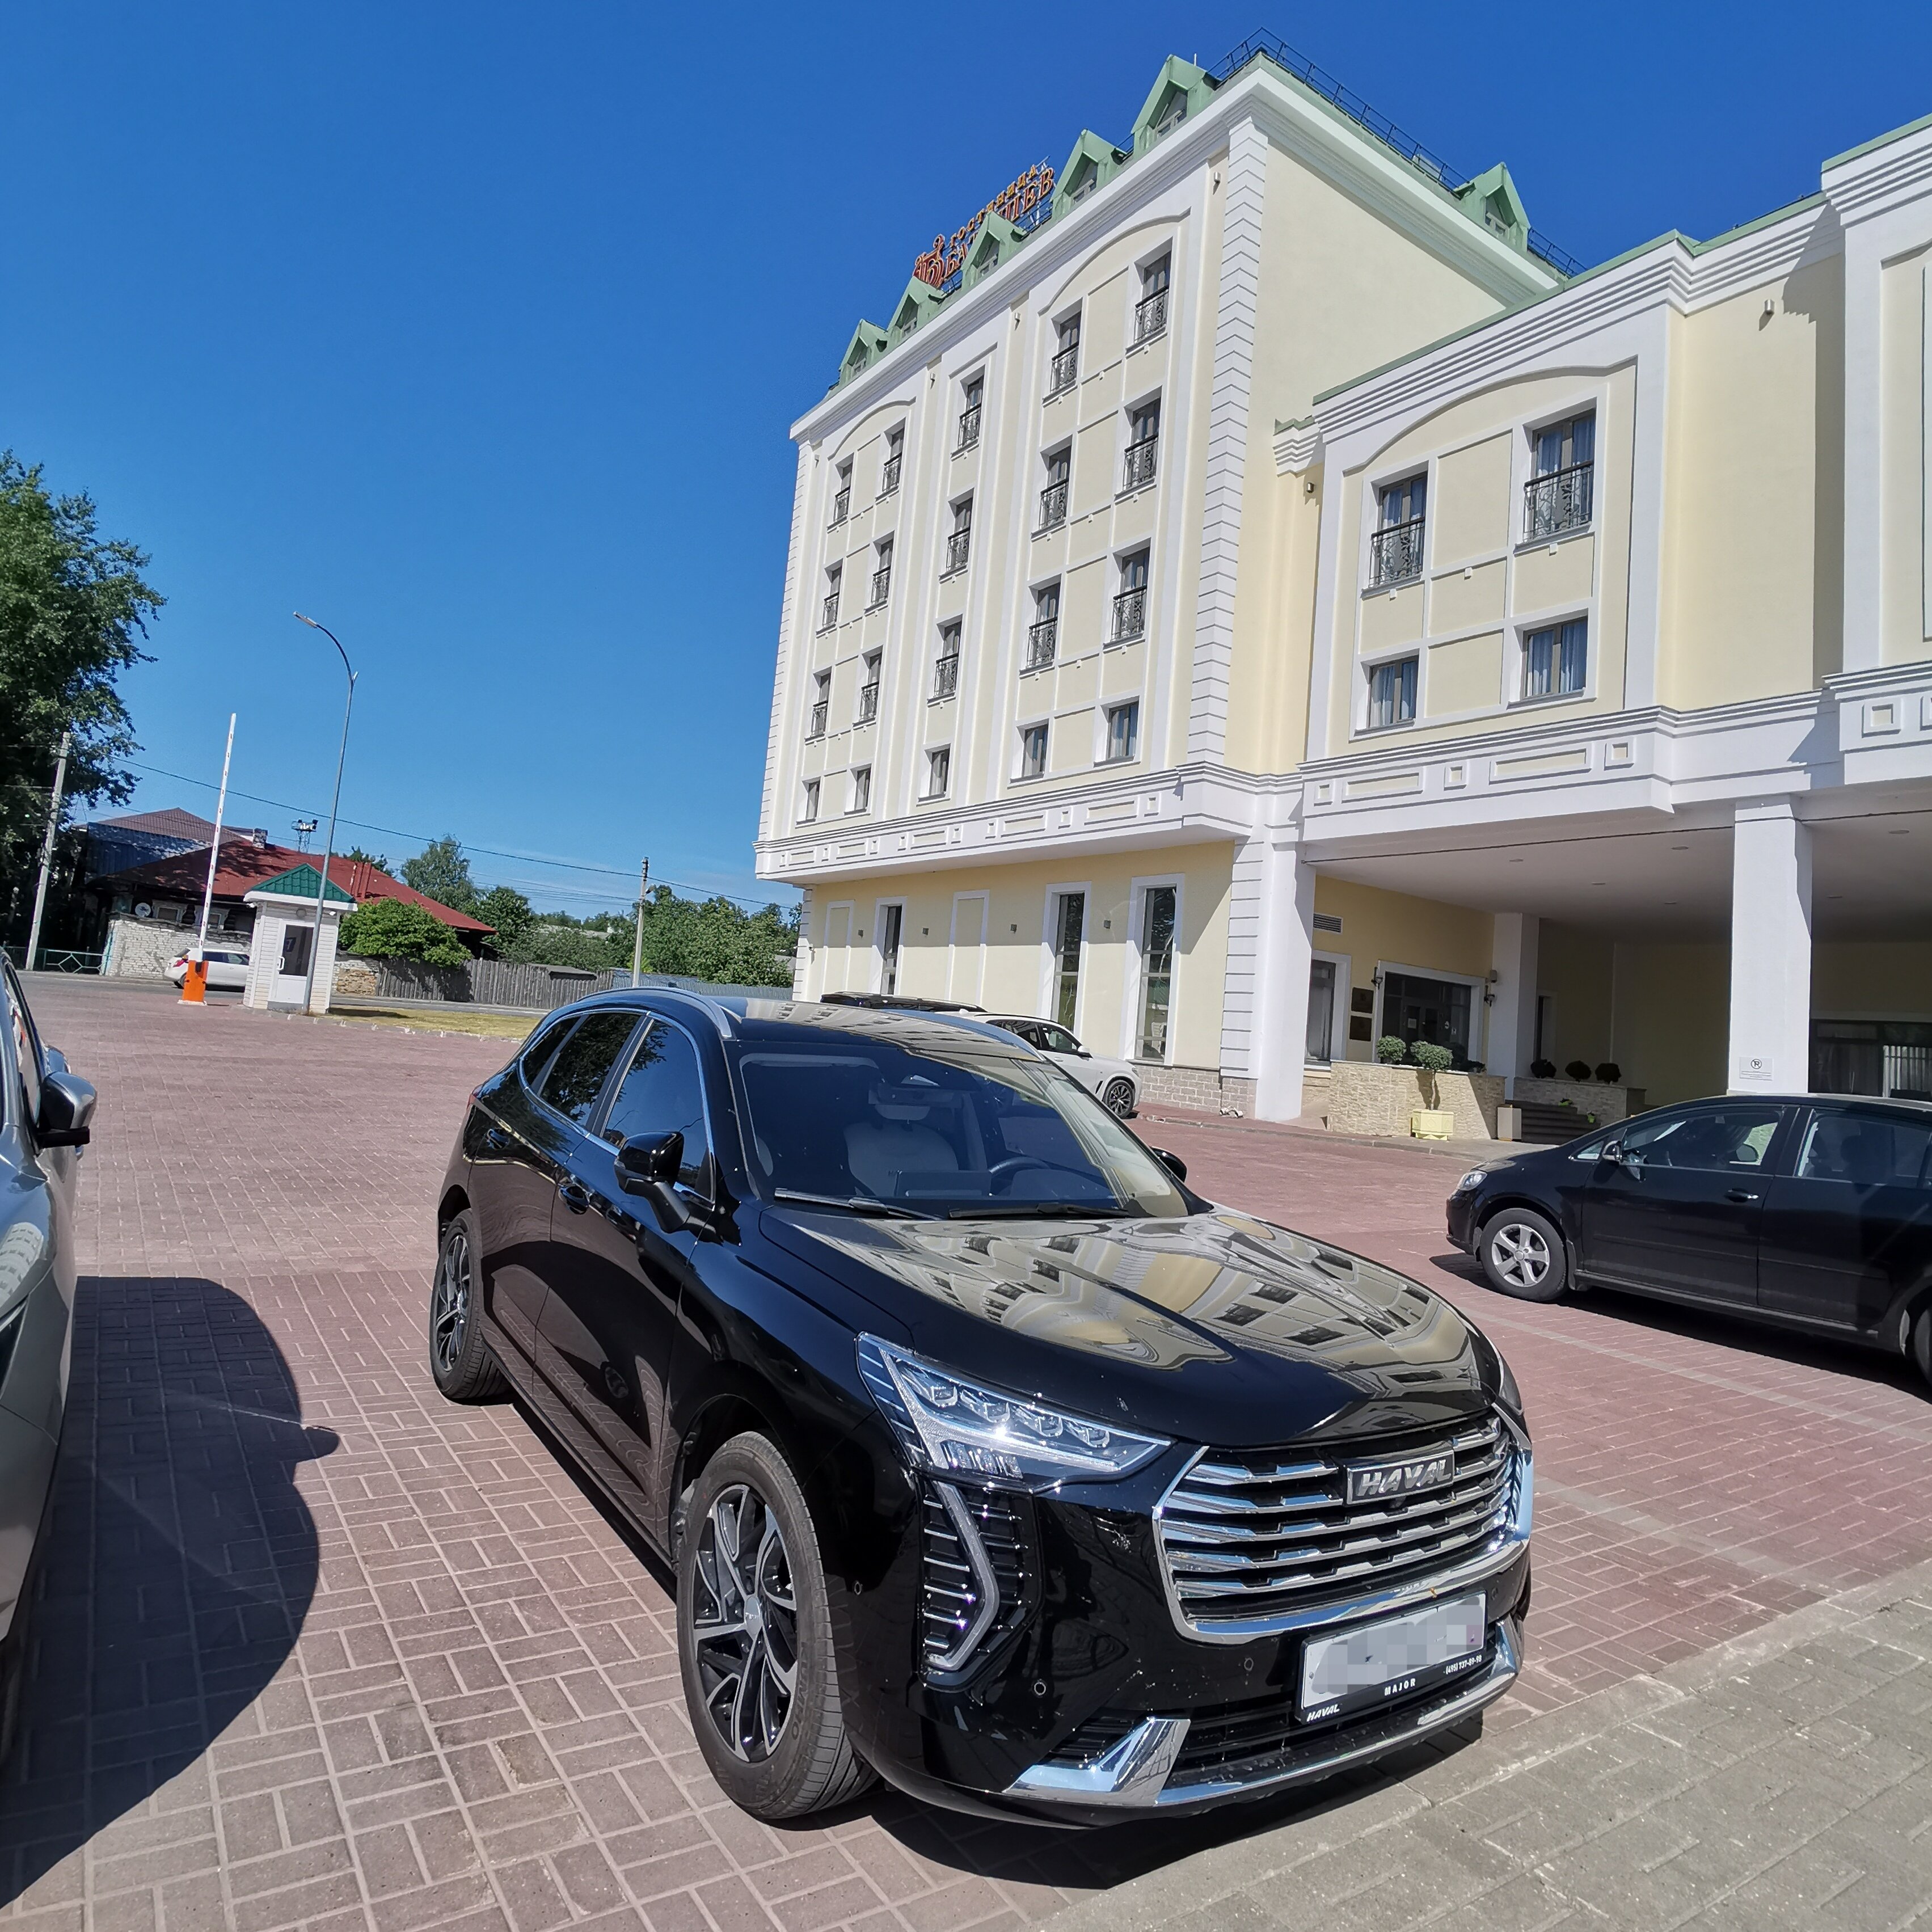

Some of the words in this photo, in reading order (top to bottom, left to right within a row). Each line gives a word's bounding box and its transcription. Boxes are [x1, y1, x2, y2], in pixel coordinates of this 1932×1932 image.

[1355, 1459, 1451, 1496] HAVAL
[1445, 1663, 1458, 1675] (495)
[791, 1641, 808, 1740] KUMHO
[1384, 1678, 1416, 1696] MAJOR
[1306, 1703, 1340, 1722] HAVAL
